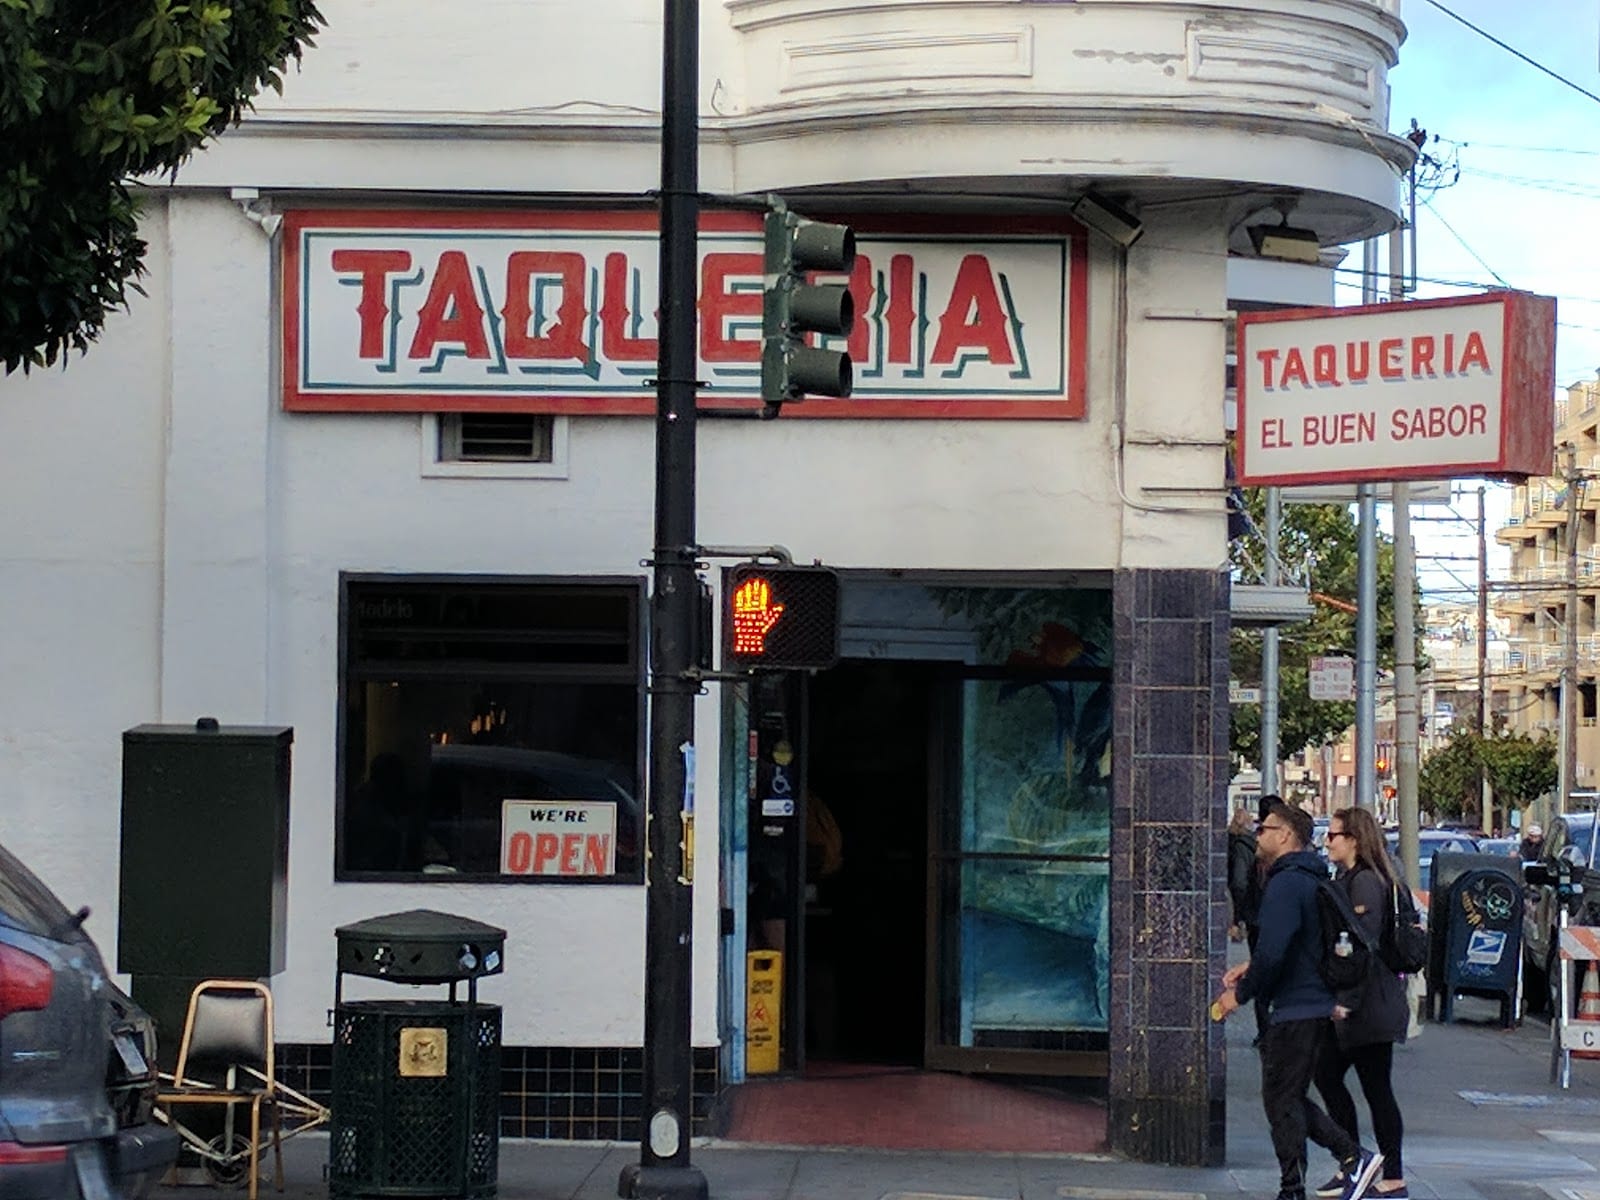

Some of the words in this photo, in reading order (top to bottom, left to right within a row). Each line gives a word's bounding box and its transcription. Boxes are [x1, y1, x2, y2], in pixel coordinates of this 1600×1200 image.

[1256, 331, 1493, 392] TAQUERIA
[1261, 419, 1293, 449] EL
[1303, 412, 1376, 447] BUEN
[1390, 403, 1487, 441] SABOR
[530, 809, 588, 823] WE'RE
[508, 831, 611, 876] OPEN
